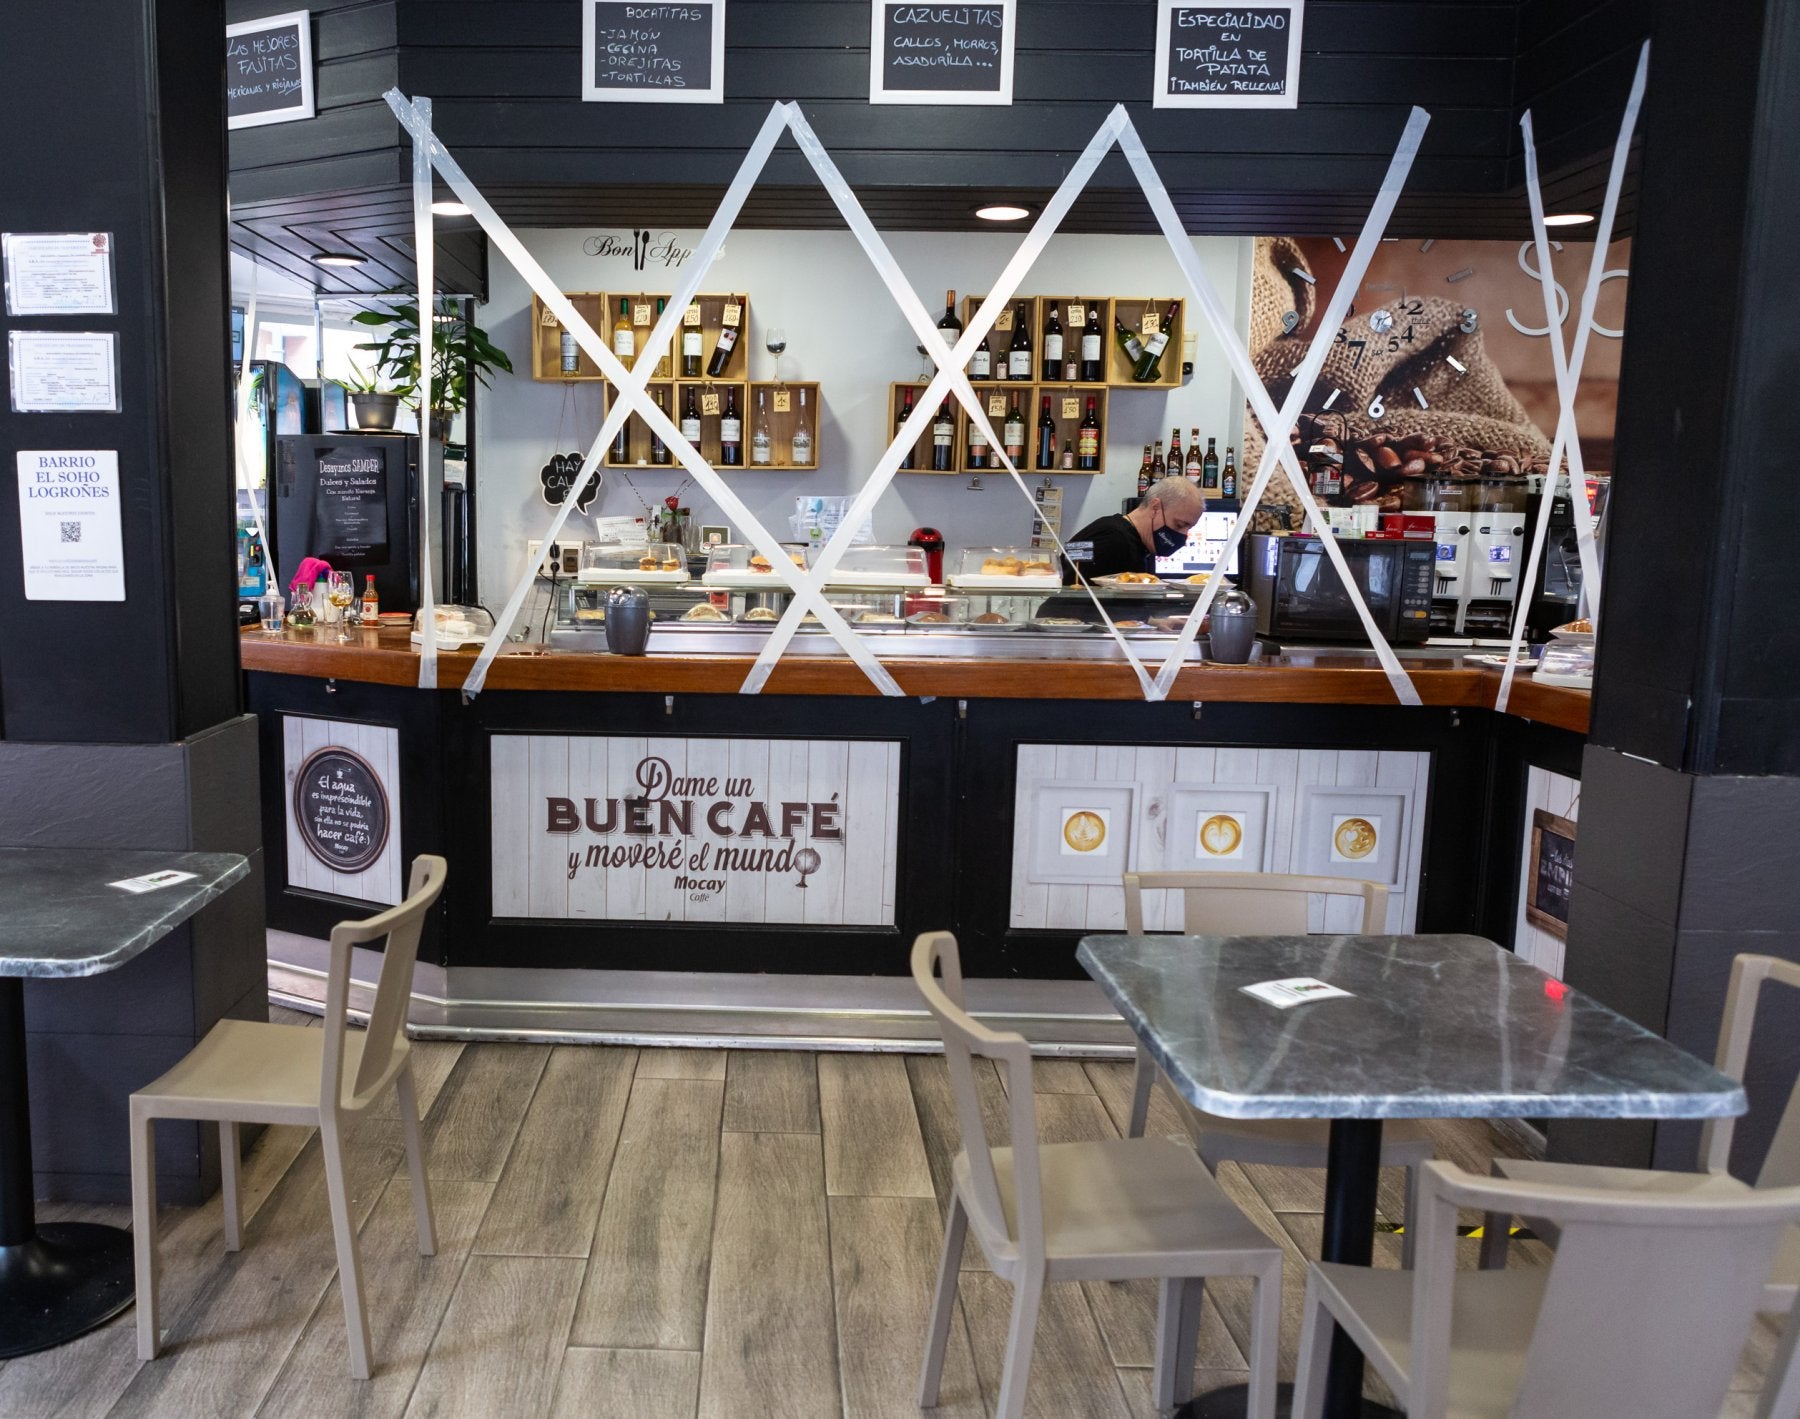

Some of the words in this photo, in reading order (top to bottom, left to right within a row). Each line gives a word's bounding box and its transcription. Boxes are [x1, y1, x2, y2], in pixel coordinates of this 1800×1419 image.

[893, 7, 1003, 28] CAZUELITAS
[1178, 9, 1286, 29] ESPECIALIDAD
[1220, 32, 1242, 41] EN
[1176, 45, 1242, 62] TORTILLA
[1247, 50, 1267, 61] DE
[237, 53, 298, 75] FAJITAS
[1196, 63, 1271, 76] PATATA
[583, 235, 633, 257] Bon
[1282, 310, 1299, 334] 9
[1460, 309, 1477, 334] 3
[1401, 325, 1415, 343] 4
[1388, 336, 1399, 352] 5
[1348, 341, 1366, 369] 7
[1368, 394, 1385, 418] 6
[39, 456, 96, 468] BARRIO
[556, 461, 581, 473] HAY
[36, 472, 55, 483] EL
[58, 472, 100, 483] SOHO
[28, 484, 110, 498] LOGROÑES
[318, 775, 329, 789] El
[332, 781, 355, 796] agua
[636, 757, 719, 803] Dame
[725, 777, 755, 797] un
[319, 806, 336, 816] para
[338, 805, 344, 815] la
[546, 797, 692, 836] BUEN
[706, 792, 845, 839] CAFÉ
[317, 823, 342, 840] hacer
[568, 852, 581, 879] y
[585, 839, 684, 869] moveré
[688, 843, 709, 871] el
[674, 875, 725, 894] Mocay
